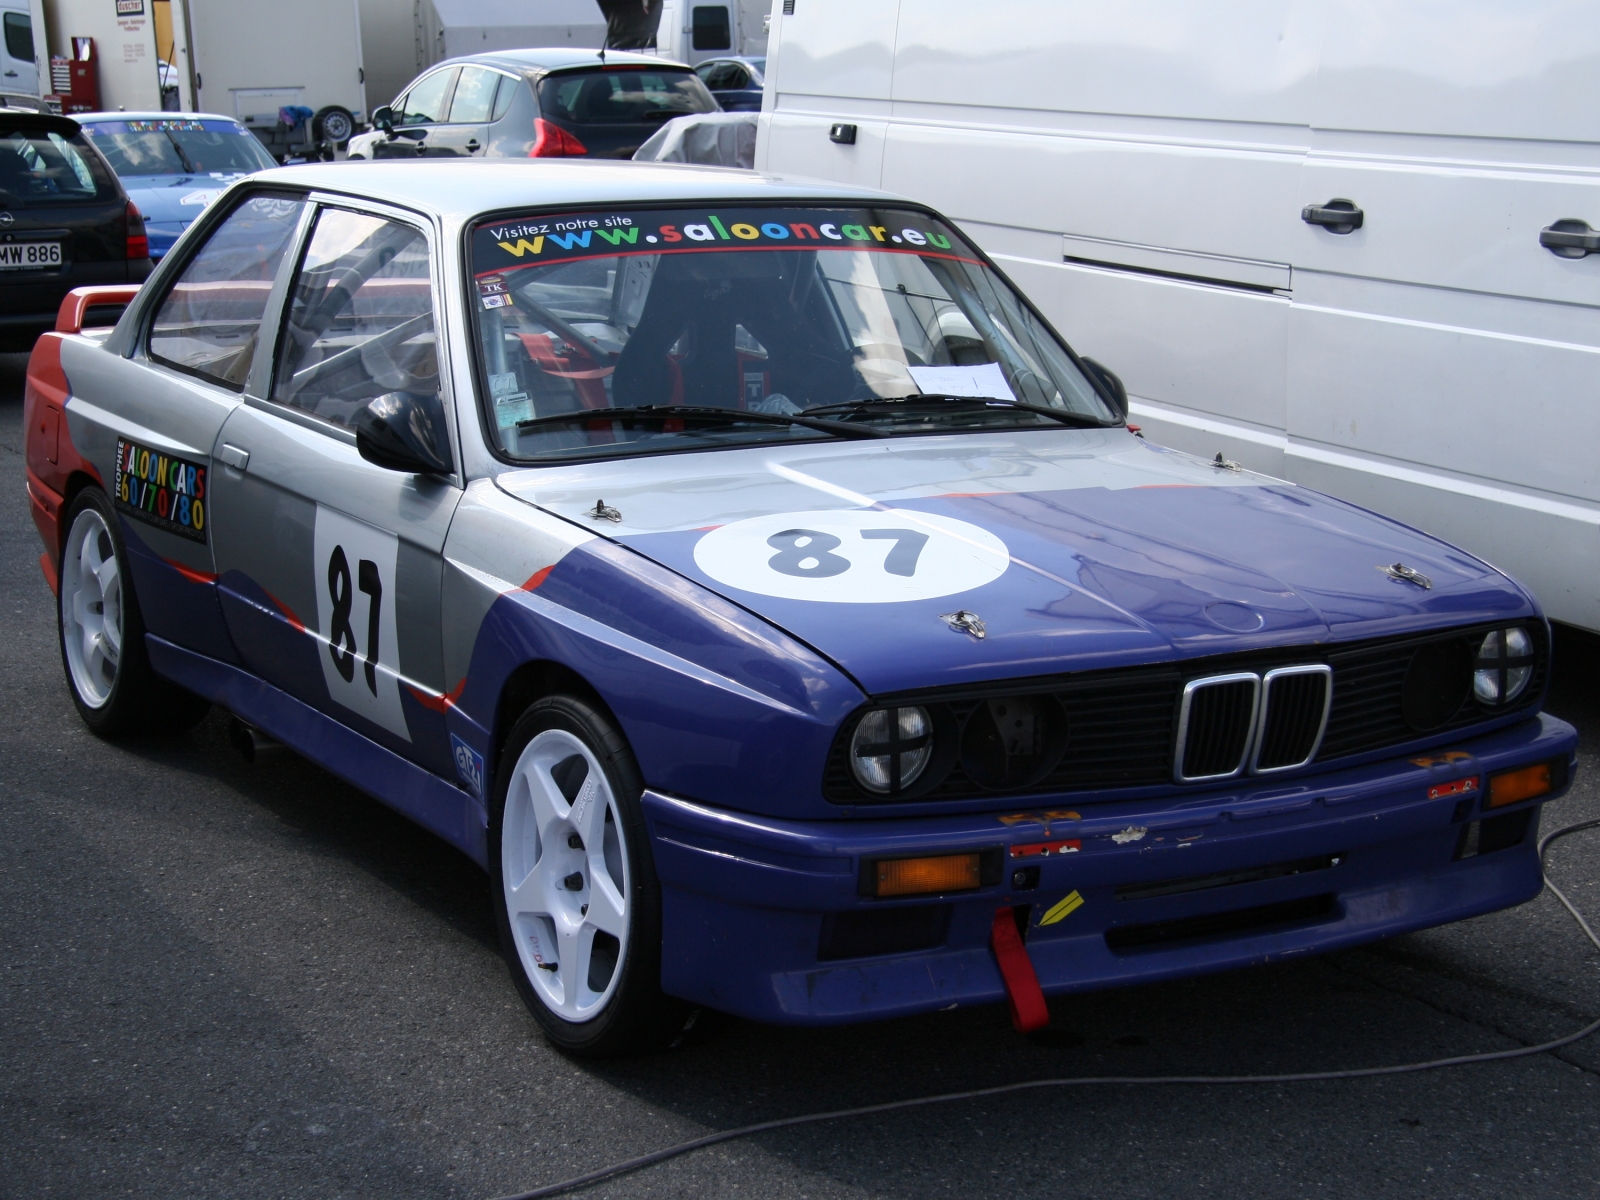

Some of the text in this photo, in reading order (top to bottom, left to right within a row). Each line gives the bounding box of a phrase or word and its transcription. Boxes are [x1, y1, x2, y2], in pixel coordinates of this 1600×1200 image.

[490, 215, 633, 240] Visitez notre site
[497, 215, 951, 257] www.salooncar.eu
[27, 246, 60, 263] 886
[484, 283, 503, 292] TK
[115, 441, 125, 498] TROPHEE
[122, 443, 205, 499] SALOON CARS
[767, 529, 930, 578] 87
[328, 544, 383, 699] 87
